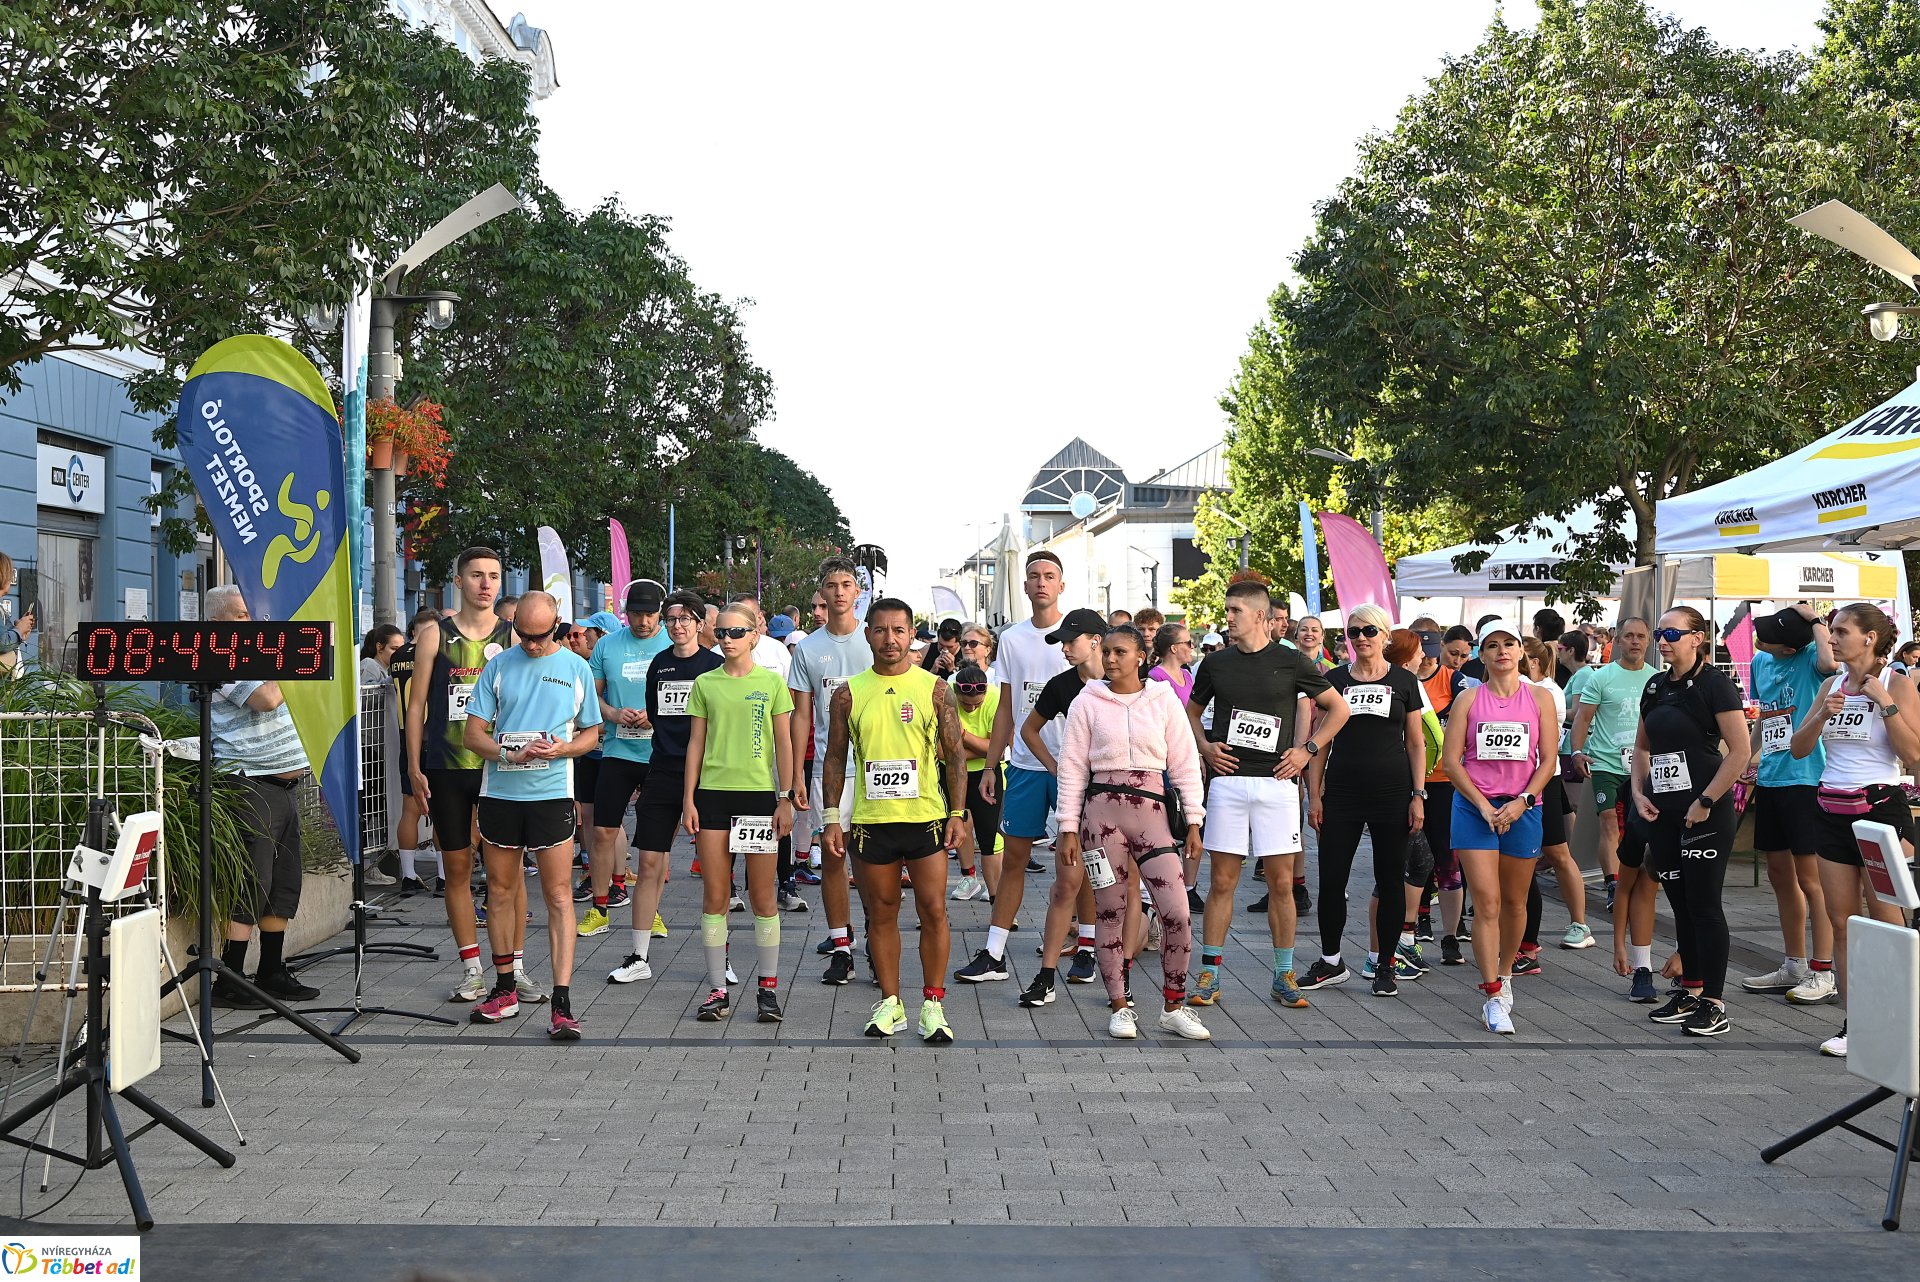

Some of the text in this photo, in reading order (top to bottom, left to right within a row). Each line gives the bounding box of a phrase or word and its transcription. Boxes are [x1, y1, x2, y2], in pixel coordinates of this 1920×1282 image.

[1837, 406, 1920, 440] KÄR
[1812, 483, 1867, 509] KÄRCHER
[1714, 507, 1758, 525] KÄRCHER
[1802, 566, 1834, 583] KÄRCHER
[86, 627, 323, 675] 08:44:43
[1350, 694, 1384, 704] 5185
[1828, 713, 1864, 726] 5150
[1236, 722, 1272, 739] 5049
[1764, 727, 1786, 743] 5145
[1485, 734, 1522, 747] 5092
[873, 772, 910, 787] 5029
[1654, 765, 1680, 780] 5182
[738, 828, 773, 841] 5148
[1681, 849, 1718, 859] PRO
